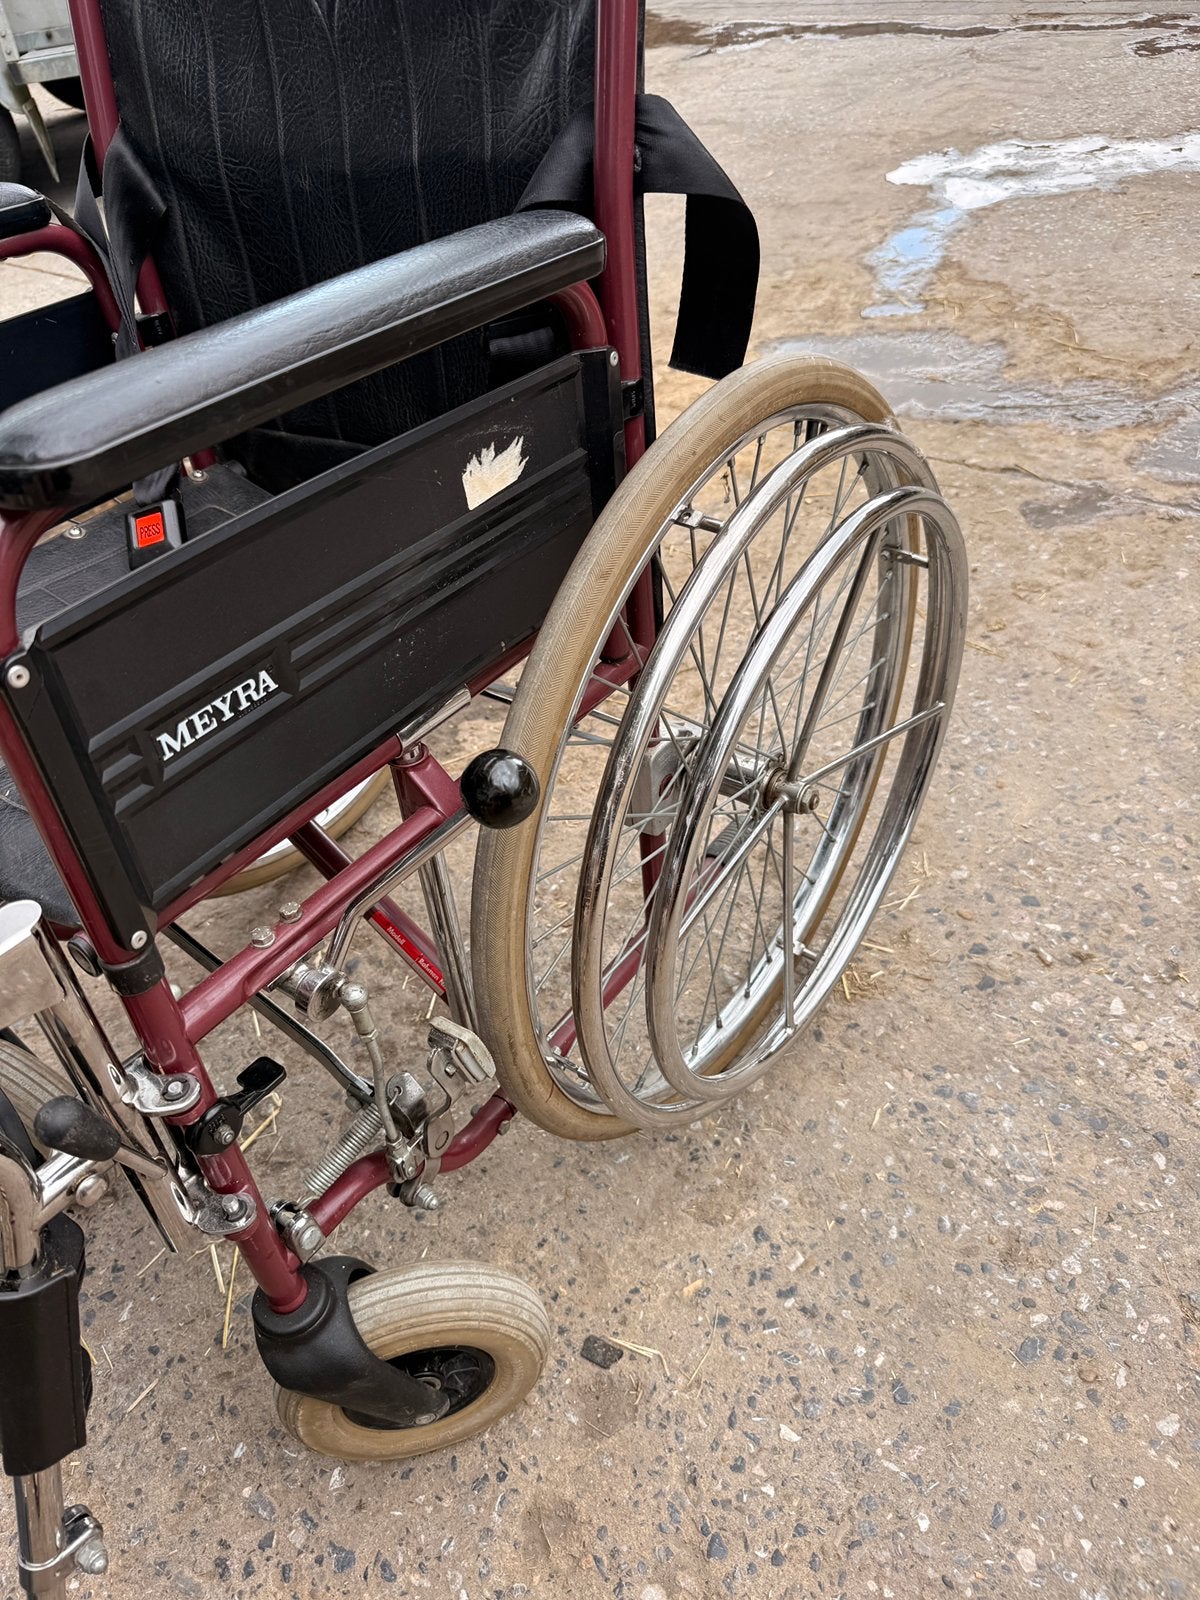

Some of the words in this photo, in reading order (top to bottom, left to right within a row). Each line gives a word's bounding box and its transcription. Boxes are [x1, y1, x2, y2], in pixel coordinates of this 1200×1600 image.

[140, 522, 161, 539] PRESS
[156, 670, 279, 761] MEYRA
[388, 927, 406, 945] Modell
[418, 958, 439, 980] Rahmen
